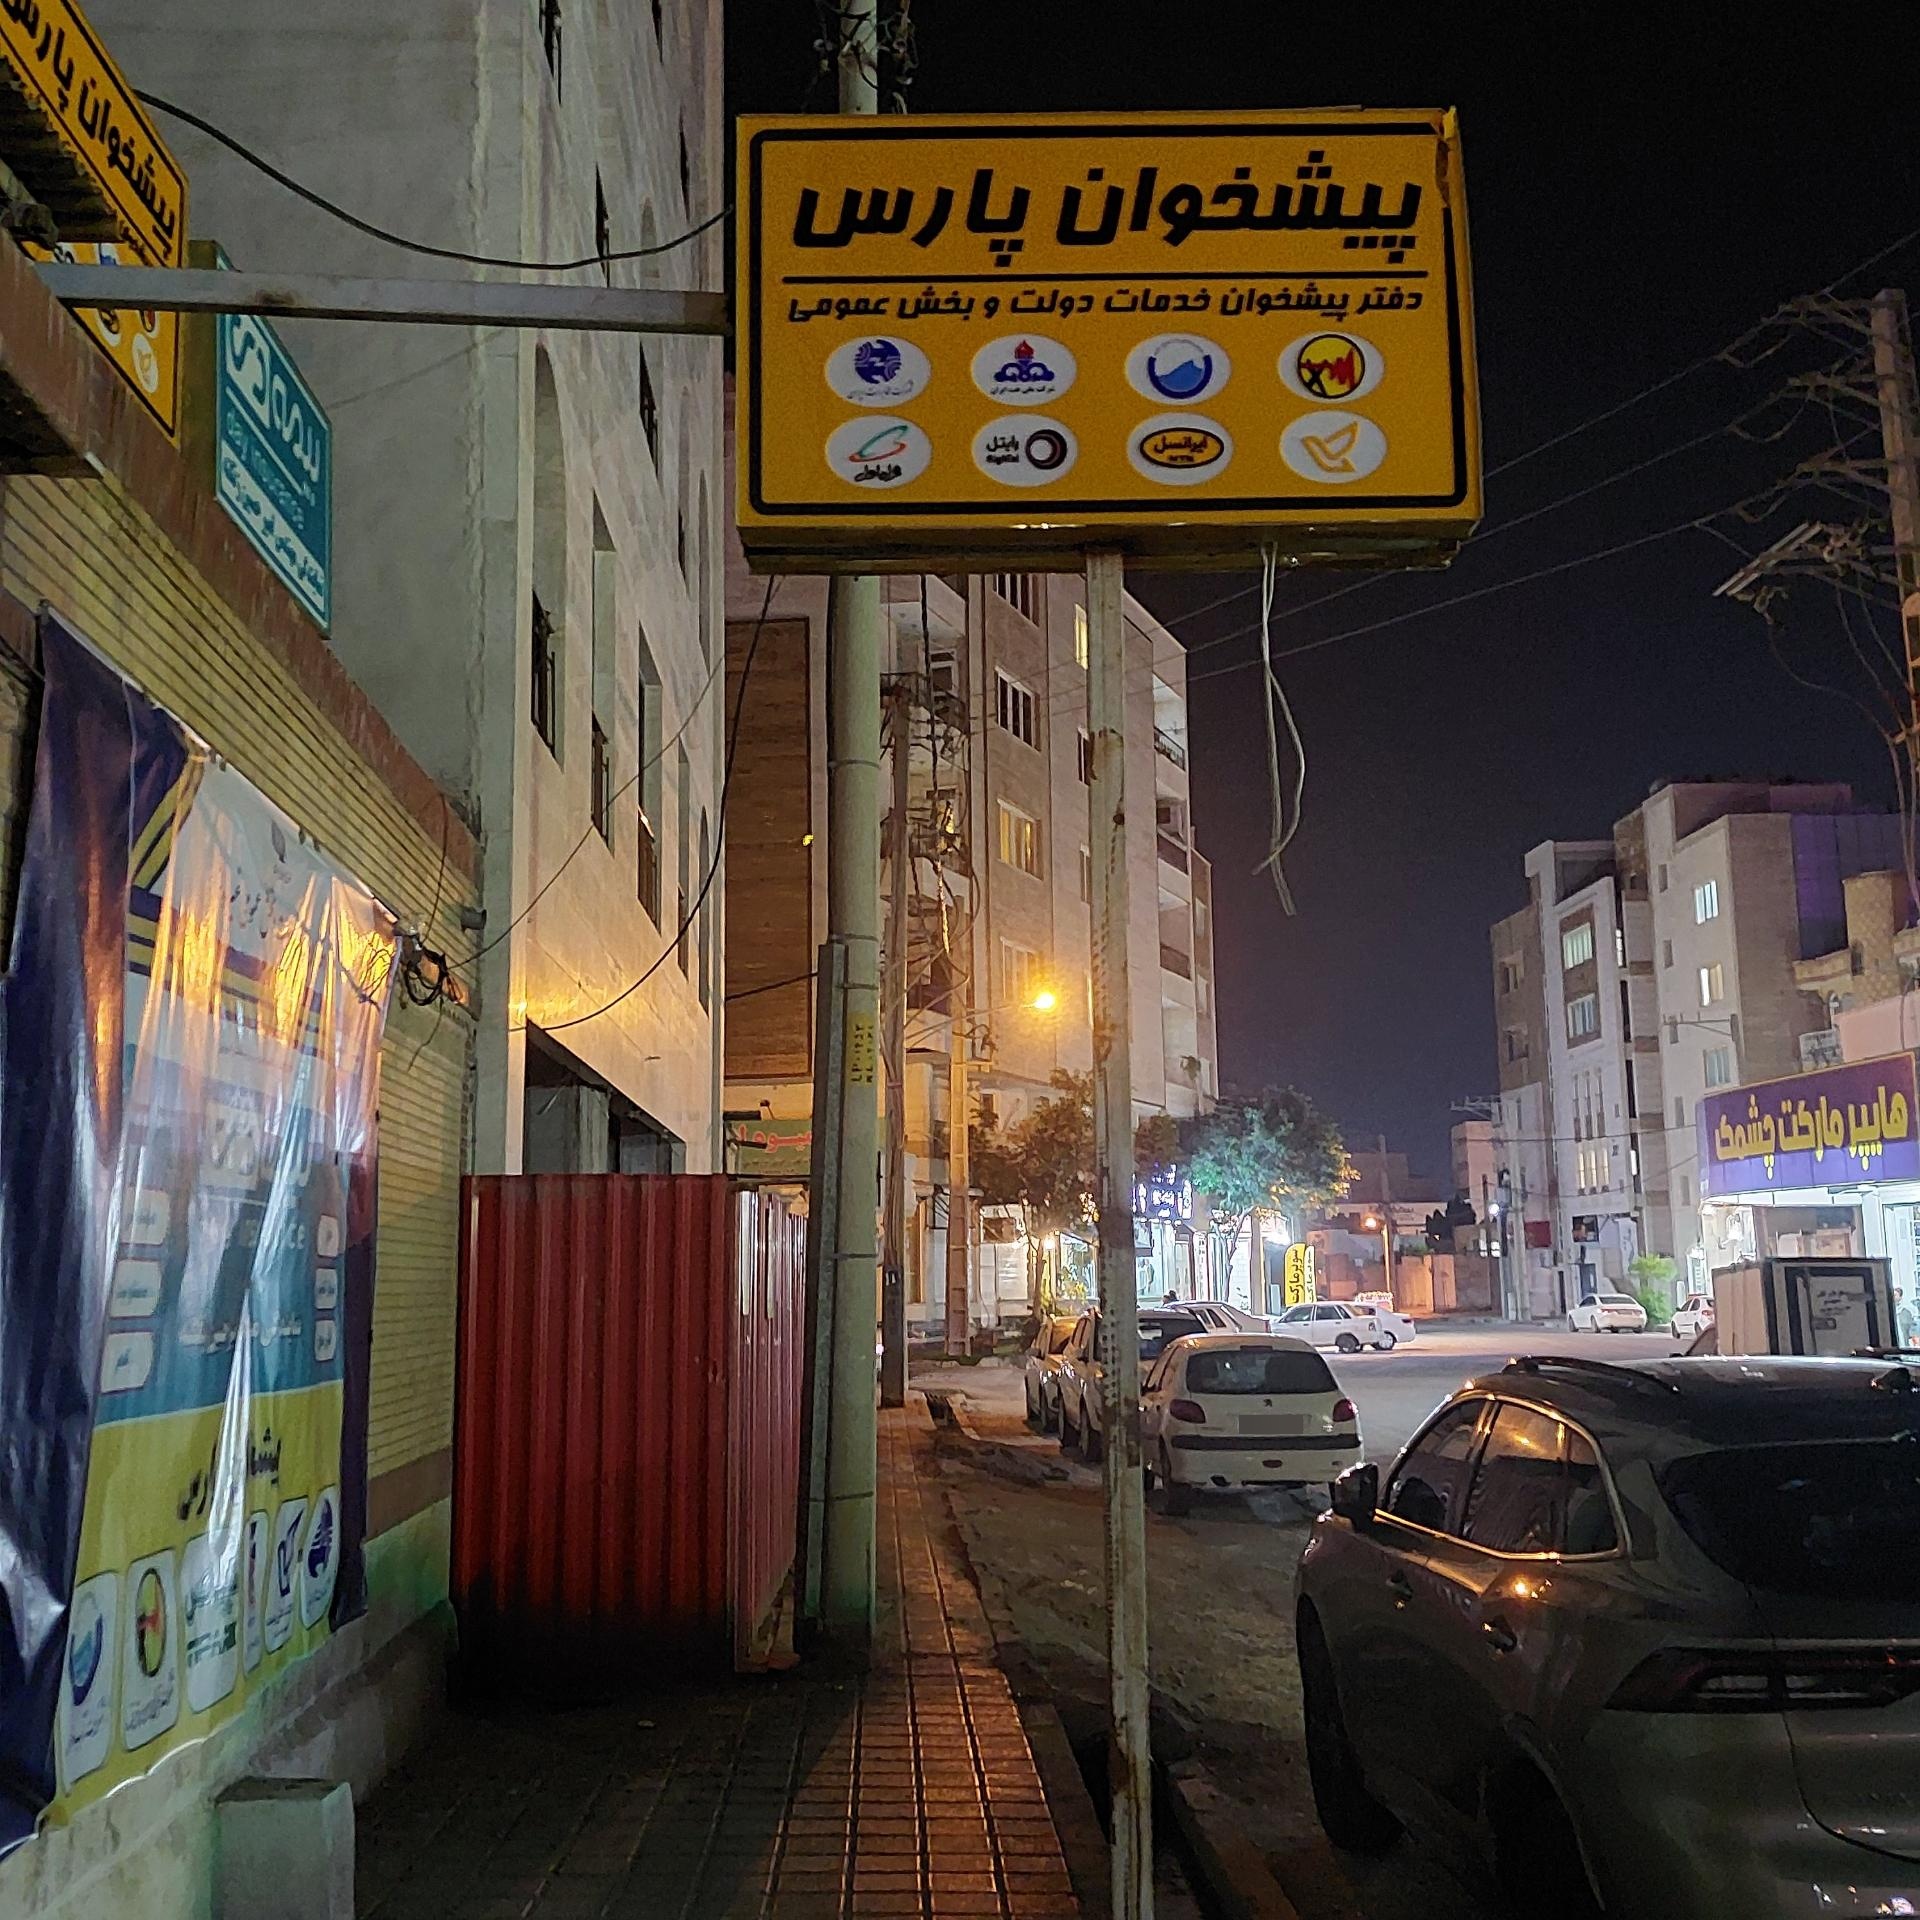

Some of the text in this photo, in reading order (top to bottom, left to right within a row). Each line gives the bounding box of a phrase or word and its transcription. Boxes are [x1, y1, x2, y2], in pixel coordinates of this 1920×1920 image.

[77, 77, 176, 260] پیشخوان
[792, 150, 1425, 268] پیشخوان پارس
[788, 284, 1423, 323] دفتر پیشخوان خدمات دولت و بخش عمومی
[986, 435, 1020, 453] رایتل
[1153, 434, 1208, 455] ایرانسل
[1714, 1086, 1909, 1180] هایپر مارکت چشمک
